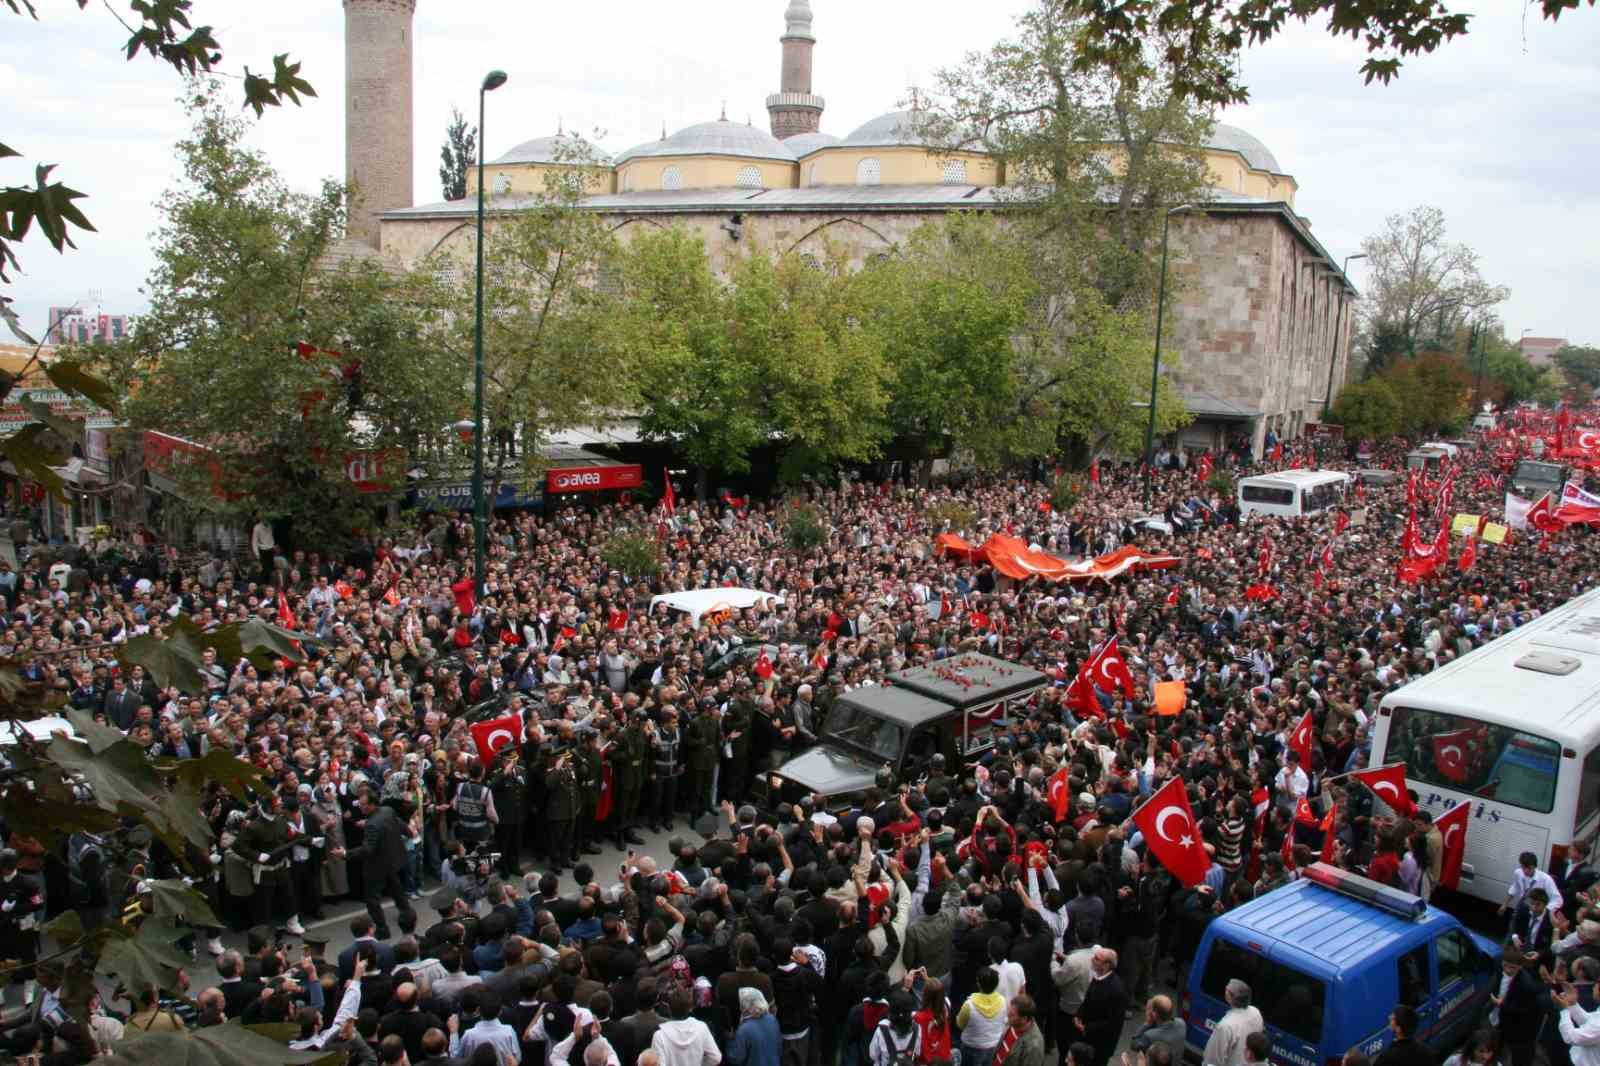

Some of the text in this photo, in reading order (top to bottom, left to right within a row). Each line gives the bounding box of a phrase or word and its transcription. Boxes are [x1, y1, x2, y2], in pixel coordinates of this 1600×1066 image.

[570, 472, 600, 486] avea
[417, 485, 503, 498] DOĞUBN
[1426, 792, 1501, 823] POİS
[1272, 1044, 1317, 1066] NDARMA
